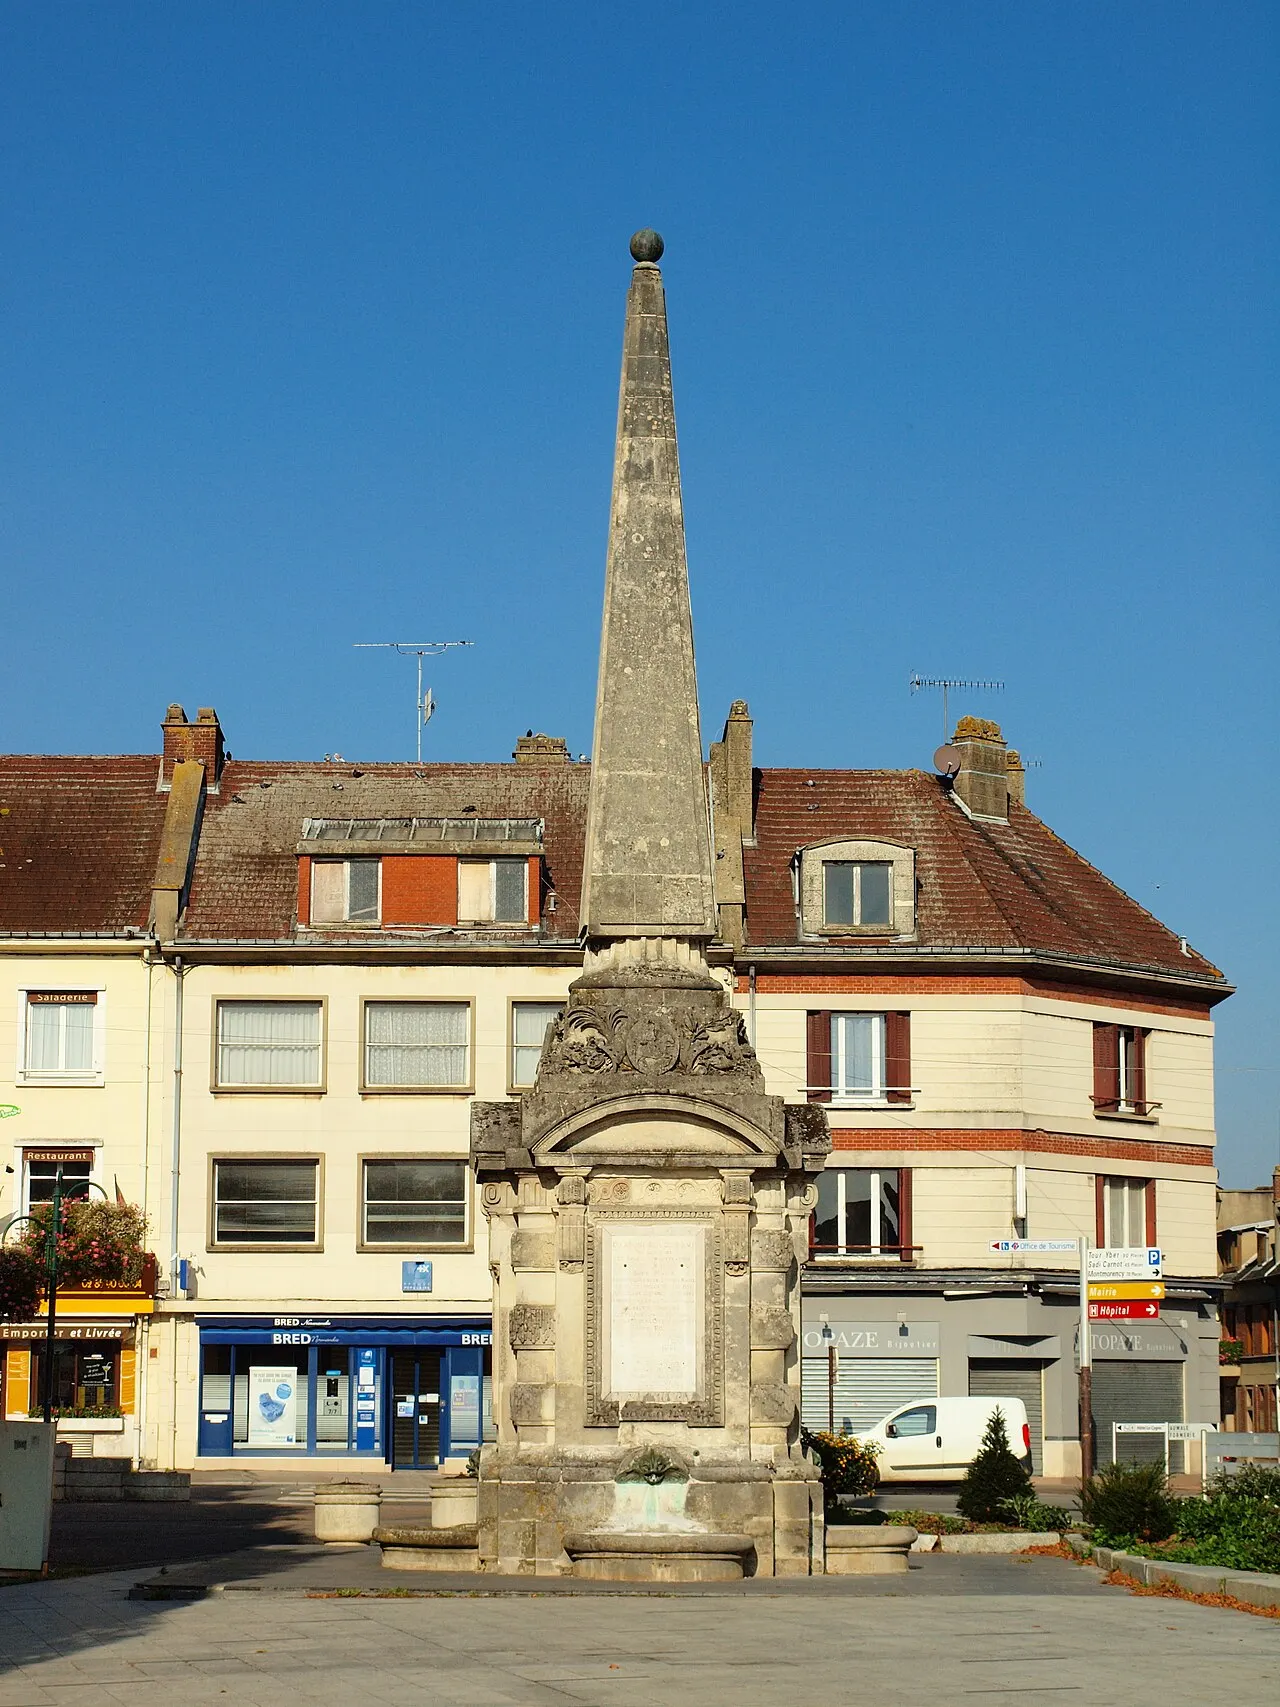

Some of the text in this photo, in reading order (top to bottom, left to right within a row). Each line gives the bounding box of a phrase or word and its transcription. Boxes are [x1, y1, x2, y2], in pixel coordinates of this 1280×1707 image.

[37, 993, 88, 1001] Saladerie
[27, 1152, 87, 1160] Restaurant
[1020, 1242, 1076, 1250] Office de Tourisme
[1088, 1251, 1102, 1259] Tour
[1150, 1251, 1158, 1264] P
[1089, 1287, 1117, 1297] Mairie
[1100, 1304, 1130, 1317] Hôpital
[274, 1318, 299, 1326] BRED
[3, 1328, 122, 1338] Emportr et Livrée
[273, 1333, 311, 1344] BRED
[887, 1340, 937, 1349] Bijoutier
